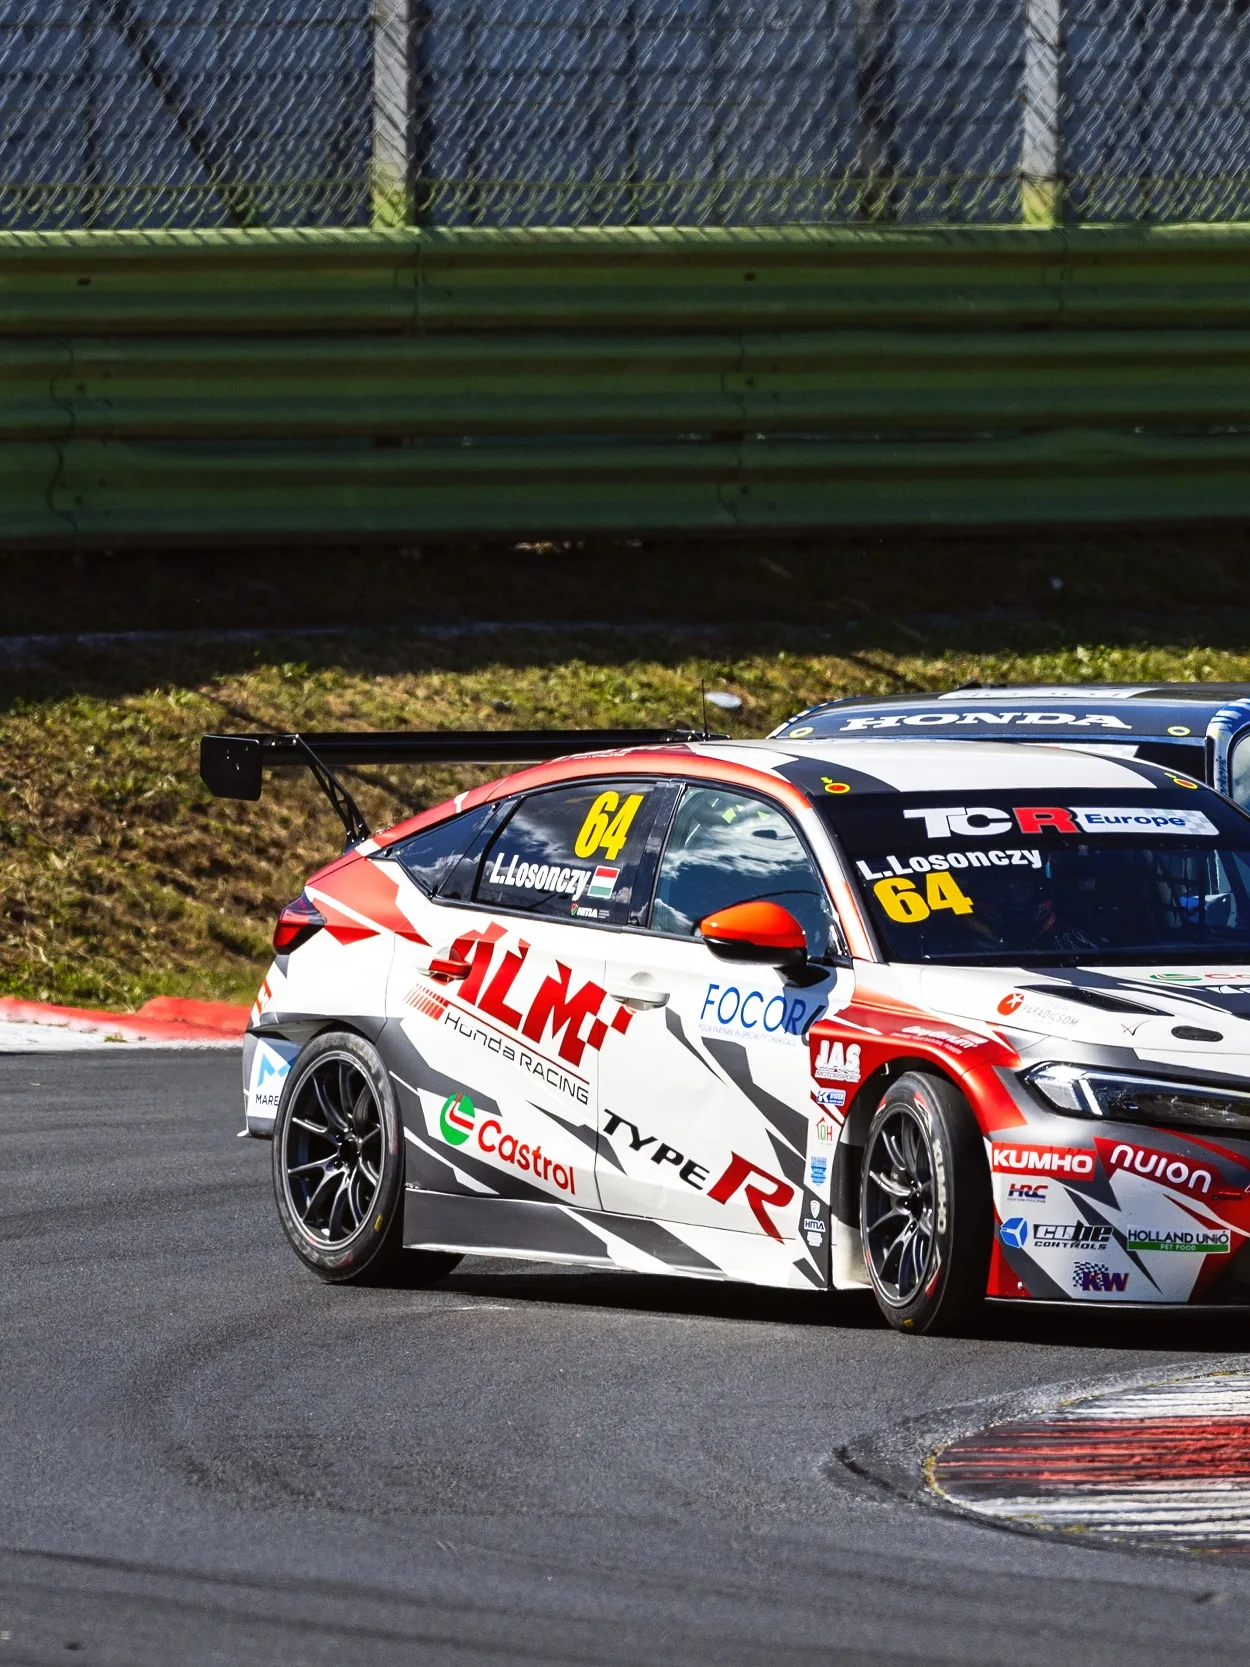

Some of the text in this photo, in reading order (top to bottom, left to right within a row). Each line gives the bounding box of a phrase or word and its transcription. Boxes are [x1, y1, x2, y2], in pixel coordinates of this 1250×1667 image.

[839, 712, 1132, 731] HONDA
[574, 790, 644, 861] 64
[903, 806, 1187, 839] TCR Europe
[873, 871, 974, 924] 64
[428, 920, 636, 1068] ALM
[701, 983, 807, 1036] FOCOR
[443, 1012, 590, 1106] Honda RACING
[815, 1039, 861, 1072] JAS
[255, 1093, 280, 1107] MARE
[477, 1119, 577, 1196] Castrol
[993, 1147, 1094, 1174] KUMHO
[603, 1108, 795, 1246] TYPE R
[1008, 1183, 1048, 1199] HRC
[1034, 1240, 1108, 1250] CONTROLS
[1128, 1229, 1194, 1244] HOLLAND
[1081, 1270, 1130, 1293] KW
